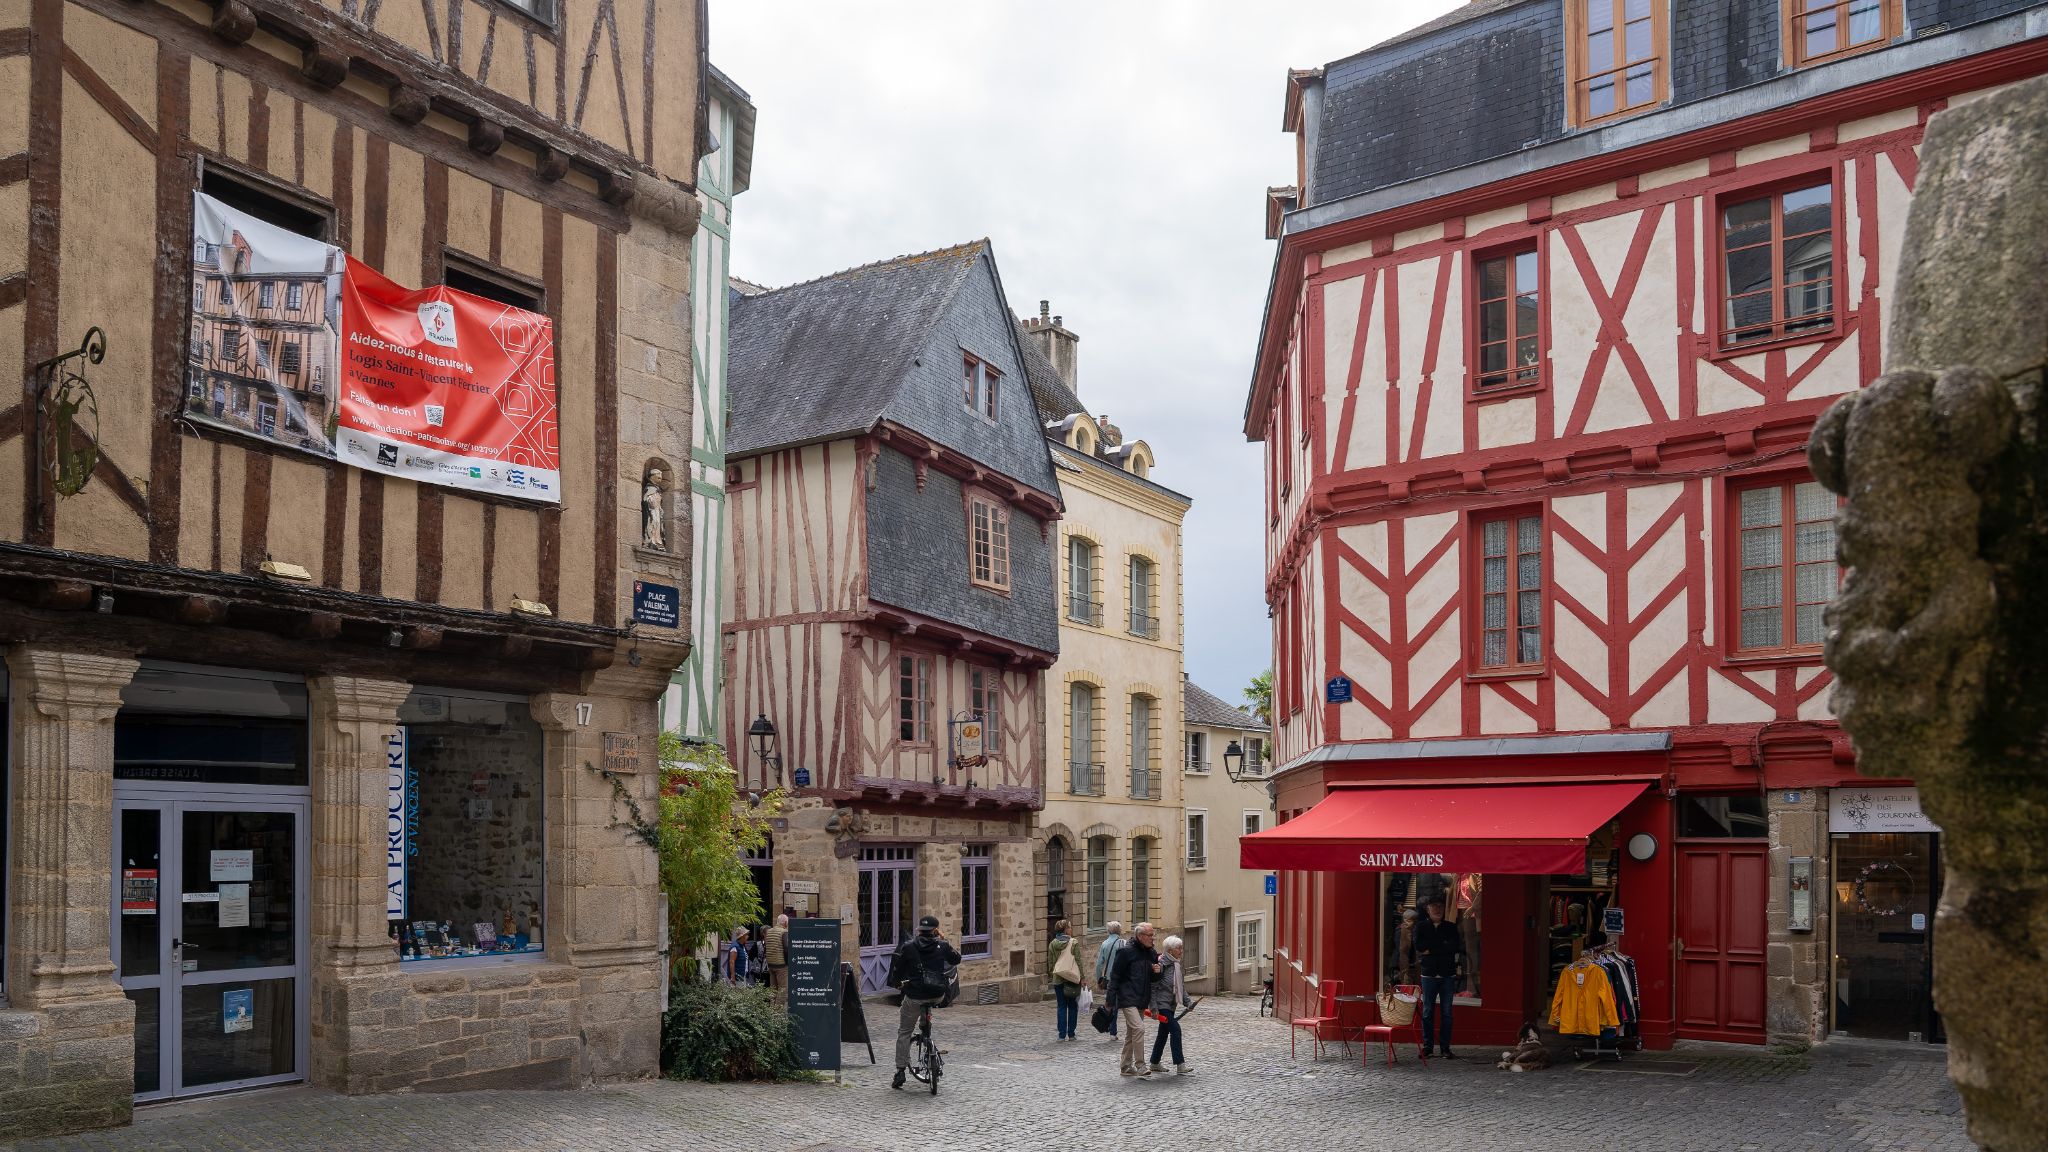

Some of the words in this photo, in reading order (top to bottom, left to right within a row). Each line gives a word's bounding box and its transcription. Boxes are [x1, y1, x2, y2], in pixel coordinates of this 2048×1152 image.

[350, 331, 416, 358] Aidez-nous
[418, 349, 423, 360] à
[425, 353, 464, 371] restaurer
[466, 362, 474, 374] le
[349, 349, 383, 369] Logis
[386, 359, 457, 385] Saint-Vincent
[458, 377, 491, 394] Ferrier
[349, 367, 354, 377] à
[355, 370, 396, 389] Vannes
[350, 390, 375, 408] Faites
[377, 403, 390, 412] un
[392, 406, 411, 417] don
[643, 600, 670, 612] VALENCIA
[648, 591, 666, 602] PLACE
[575, 702, 593, 726] 17
[387, 729, 403, 868] PROCURE
[408, 767, 419, 838] VINCENT
[1789, 793, 1795, 802] 5
[1360, 853, 1399, 867] SAINT
[1400, 853, 1444, 867] JAMES
[386, 879, 402, 916] LA
